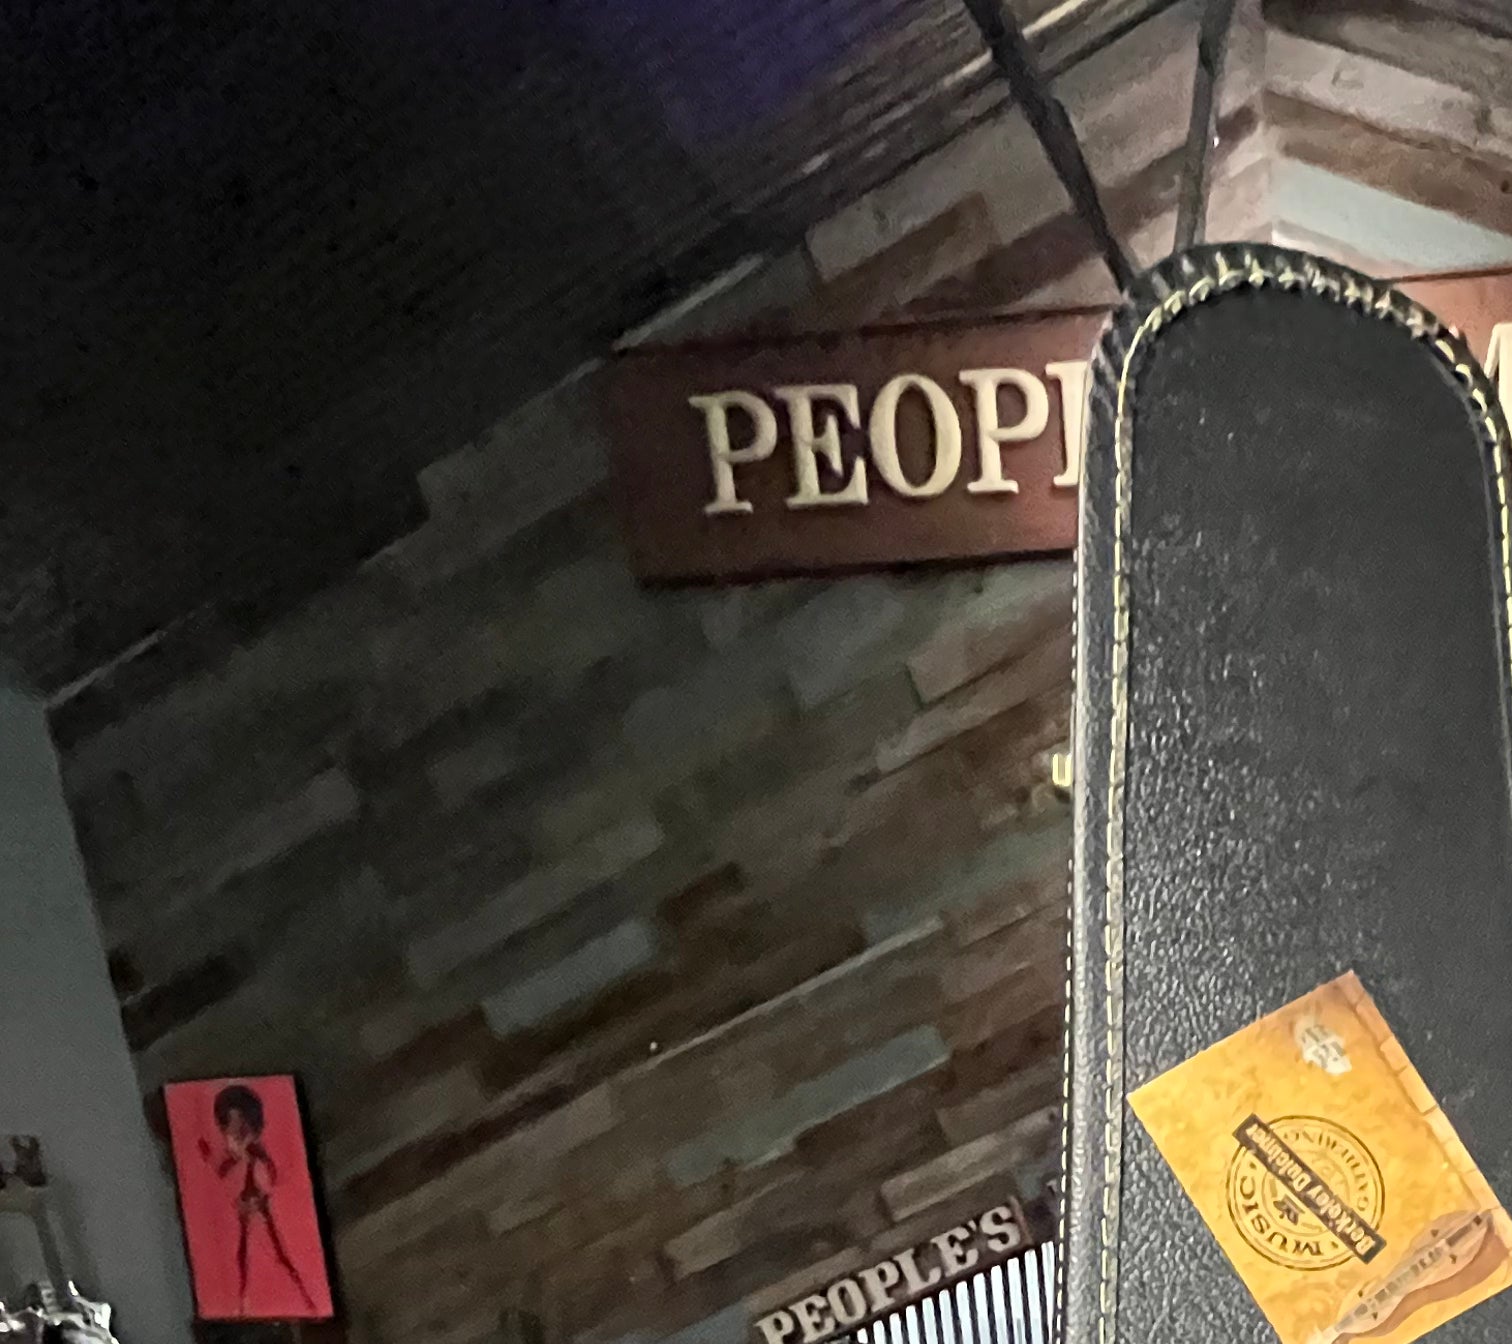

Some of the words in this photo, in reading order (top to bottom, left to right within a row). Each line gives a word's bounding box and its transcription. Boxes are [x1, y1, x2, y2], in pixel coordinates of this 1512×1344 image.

[1244, 1123, 1312, 1191] Dulcimer
[1240, 1174, 1324, 1256] MUSIC
[1306, 1185, 1376, 1256] Berkeley
